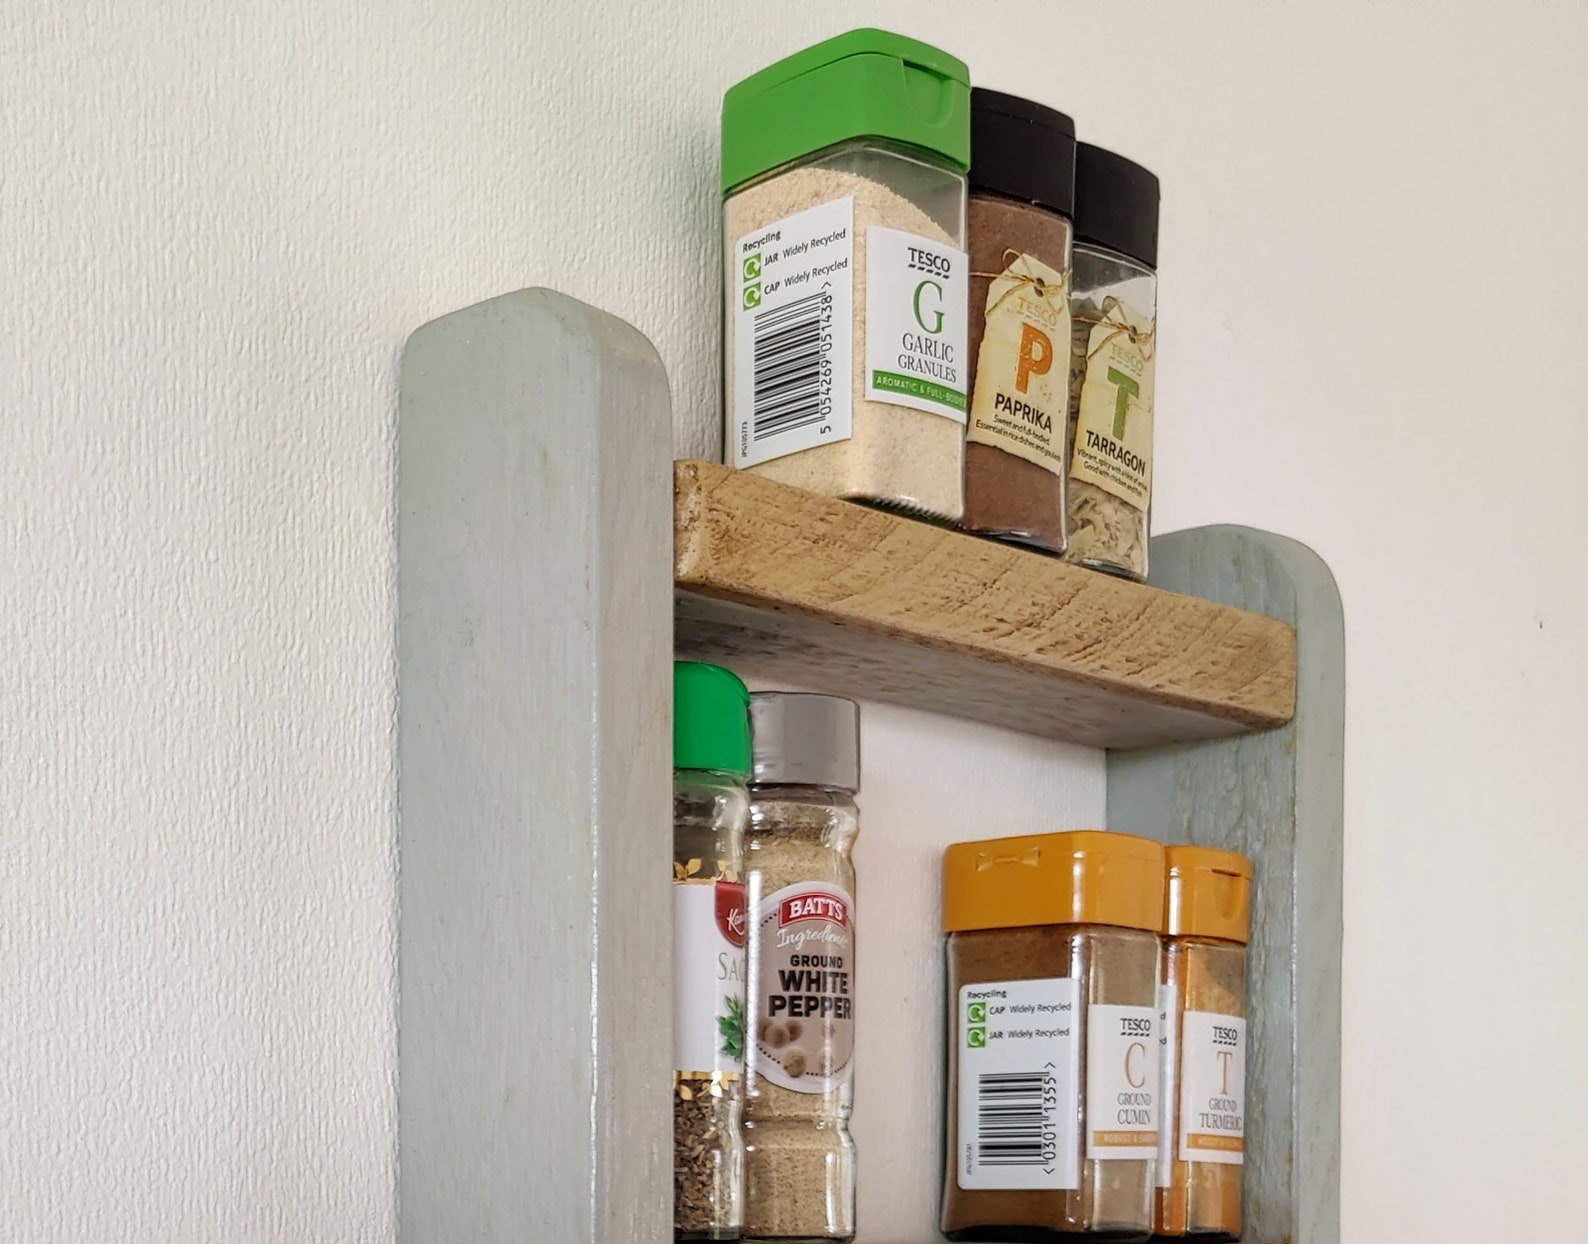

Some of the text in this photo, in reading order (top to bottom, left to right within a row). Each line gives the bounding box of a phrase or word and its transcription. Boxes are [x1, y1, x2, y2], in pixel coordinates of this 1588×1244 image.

[743, 230, 781, 253] Recycling
[764, 228, 846, 267] JAR Widely Recycled
[908, 247, 951, 273] TESCO
[764, 257, 848, 295] CAP Widely Recycled
[912, 280, 945, 335] G
[1018, 297, 1057, 326] TESCO
[902, 332, 954, 363] GARLIC
[1016, 322, 1053, 394] P
[1111, 343, 1144, 372] TESCO
[898, 354, 956, 383] GRANULES
[876, 376, 919, 392] AROMATIC
[995, 392, 1052, 434] PAPRIKA
[1107, 366, 1140, 442] T
[976, 419, 1002, 436] Essential
[1086, 429, 1146, 477] TARRAGON
[789, 897, 843, 921] BATTS
[790, 954, 843, 969] GROUND
[778, 970, 848, 994] WHITE
[967, 990, 1007, 999] Recycling
[768, 995, 852, 1020] PEPPER
[989, 1002, 1072, 1015] CAP Widely Recycled
[988, 1027, 1070, 1040] JAR Widely Recycled
[1120, 1018, 1150, 1031] TESCO
[1212, 1026, 1238, 1041] TESCO
[1124, 1042, 1146, 1088] C
[1217, 1051, 1233, 1095] T
[1117, 1092, 1151, 1105] GROUND
[1209, 1097, 1237, 1112] GROUND
[1117, 1109, 1151, 1125] CUMIN
[1199, 1113, 1242, 1131] TURMERIC
